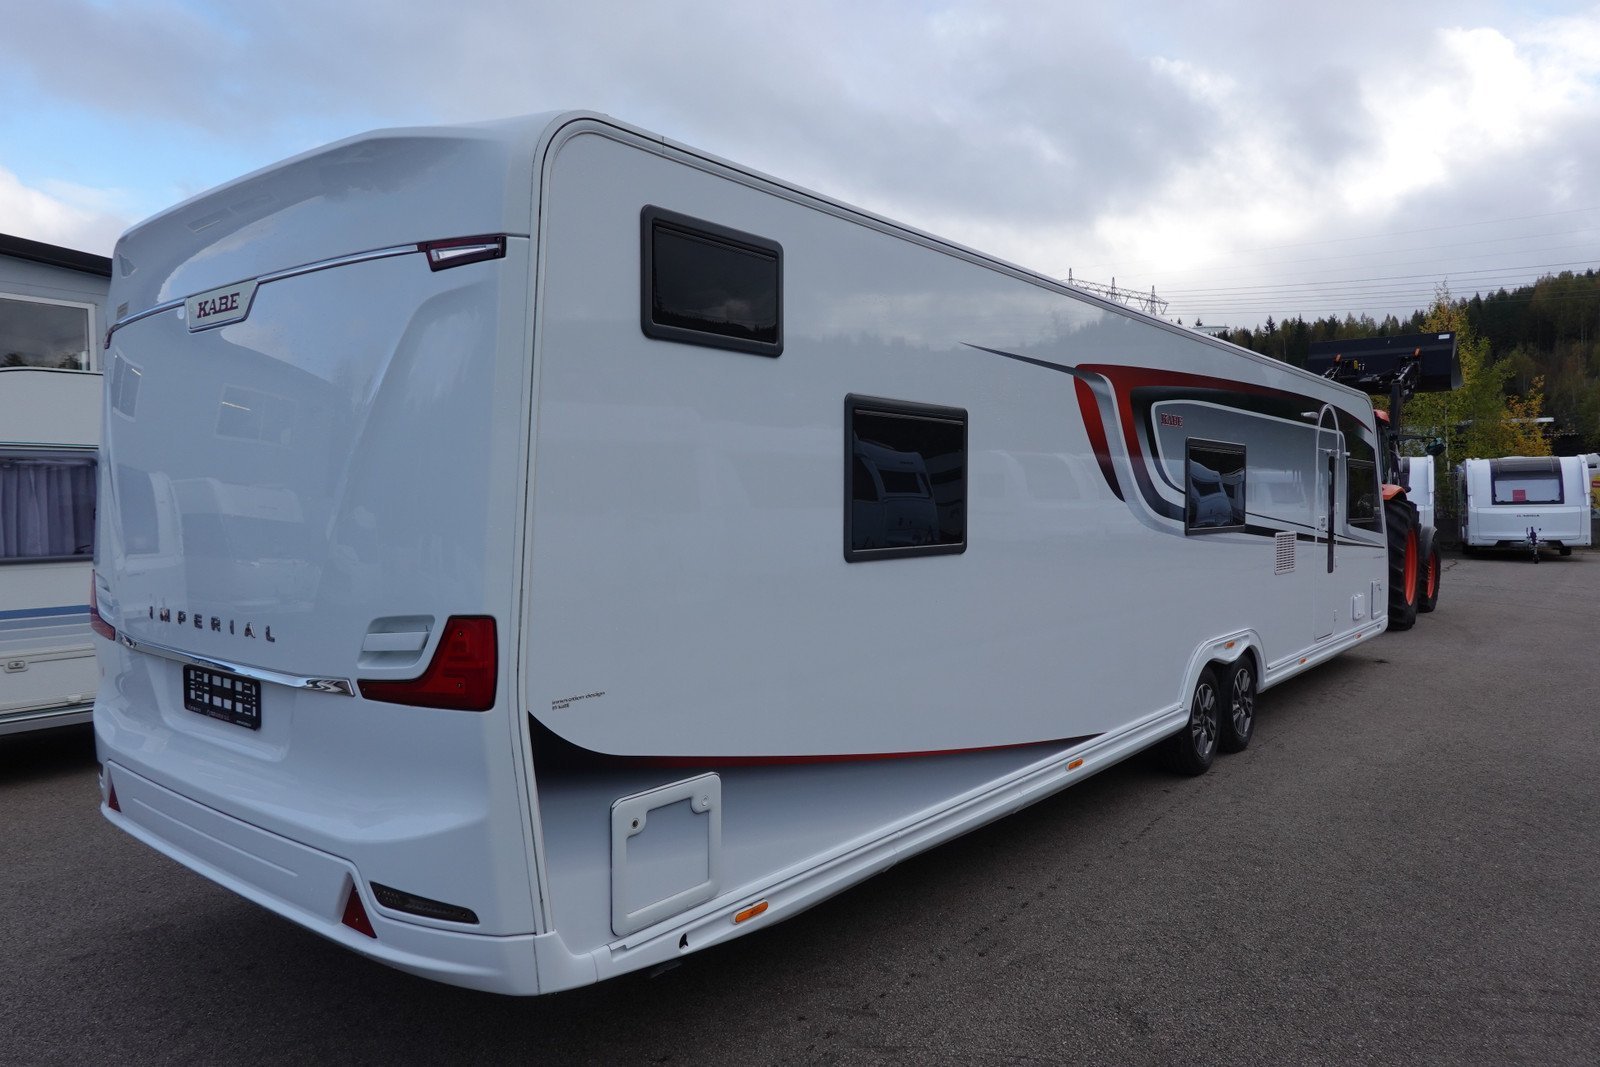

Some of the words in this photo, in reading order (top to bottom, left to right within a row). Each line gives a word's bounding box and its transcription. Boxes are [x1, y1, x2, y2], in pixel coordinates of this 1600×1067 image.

[197, 292, 240, 318] KABE
[1161, 412, 1183, 427] KABE
[149, 606, 275, 642] IMPERIAL
